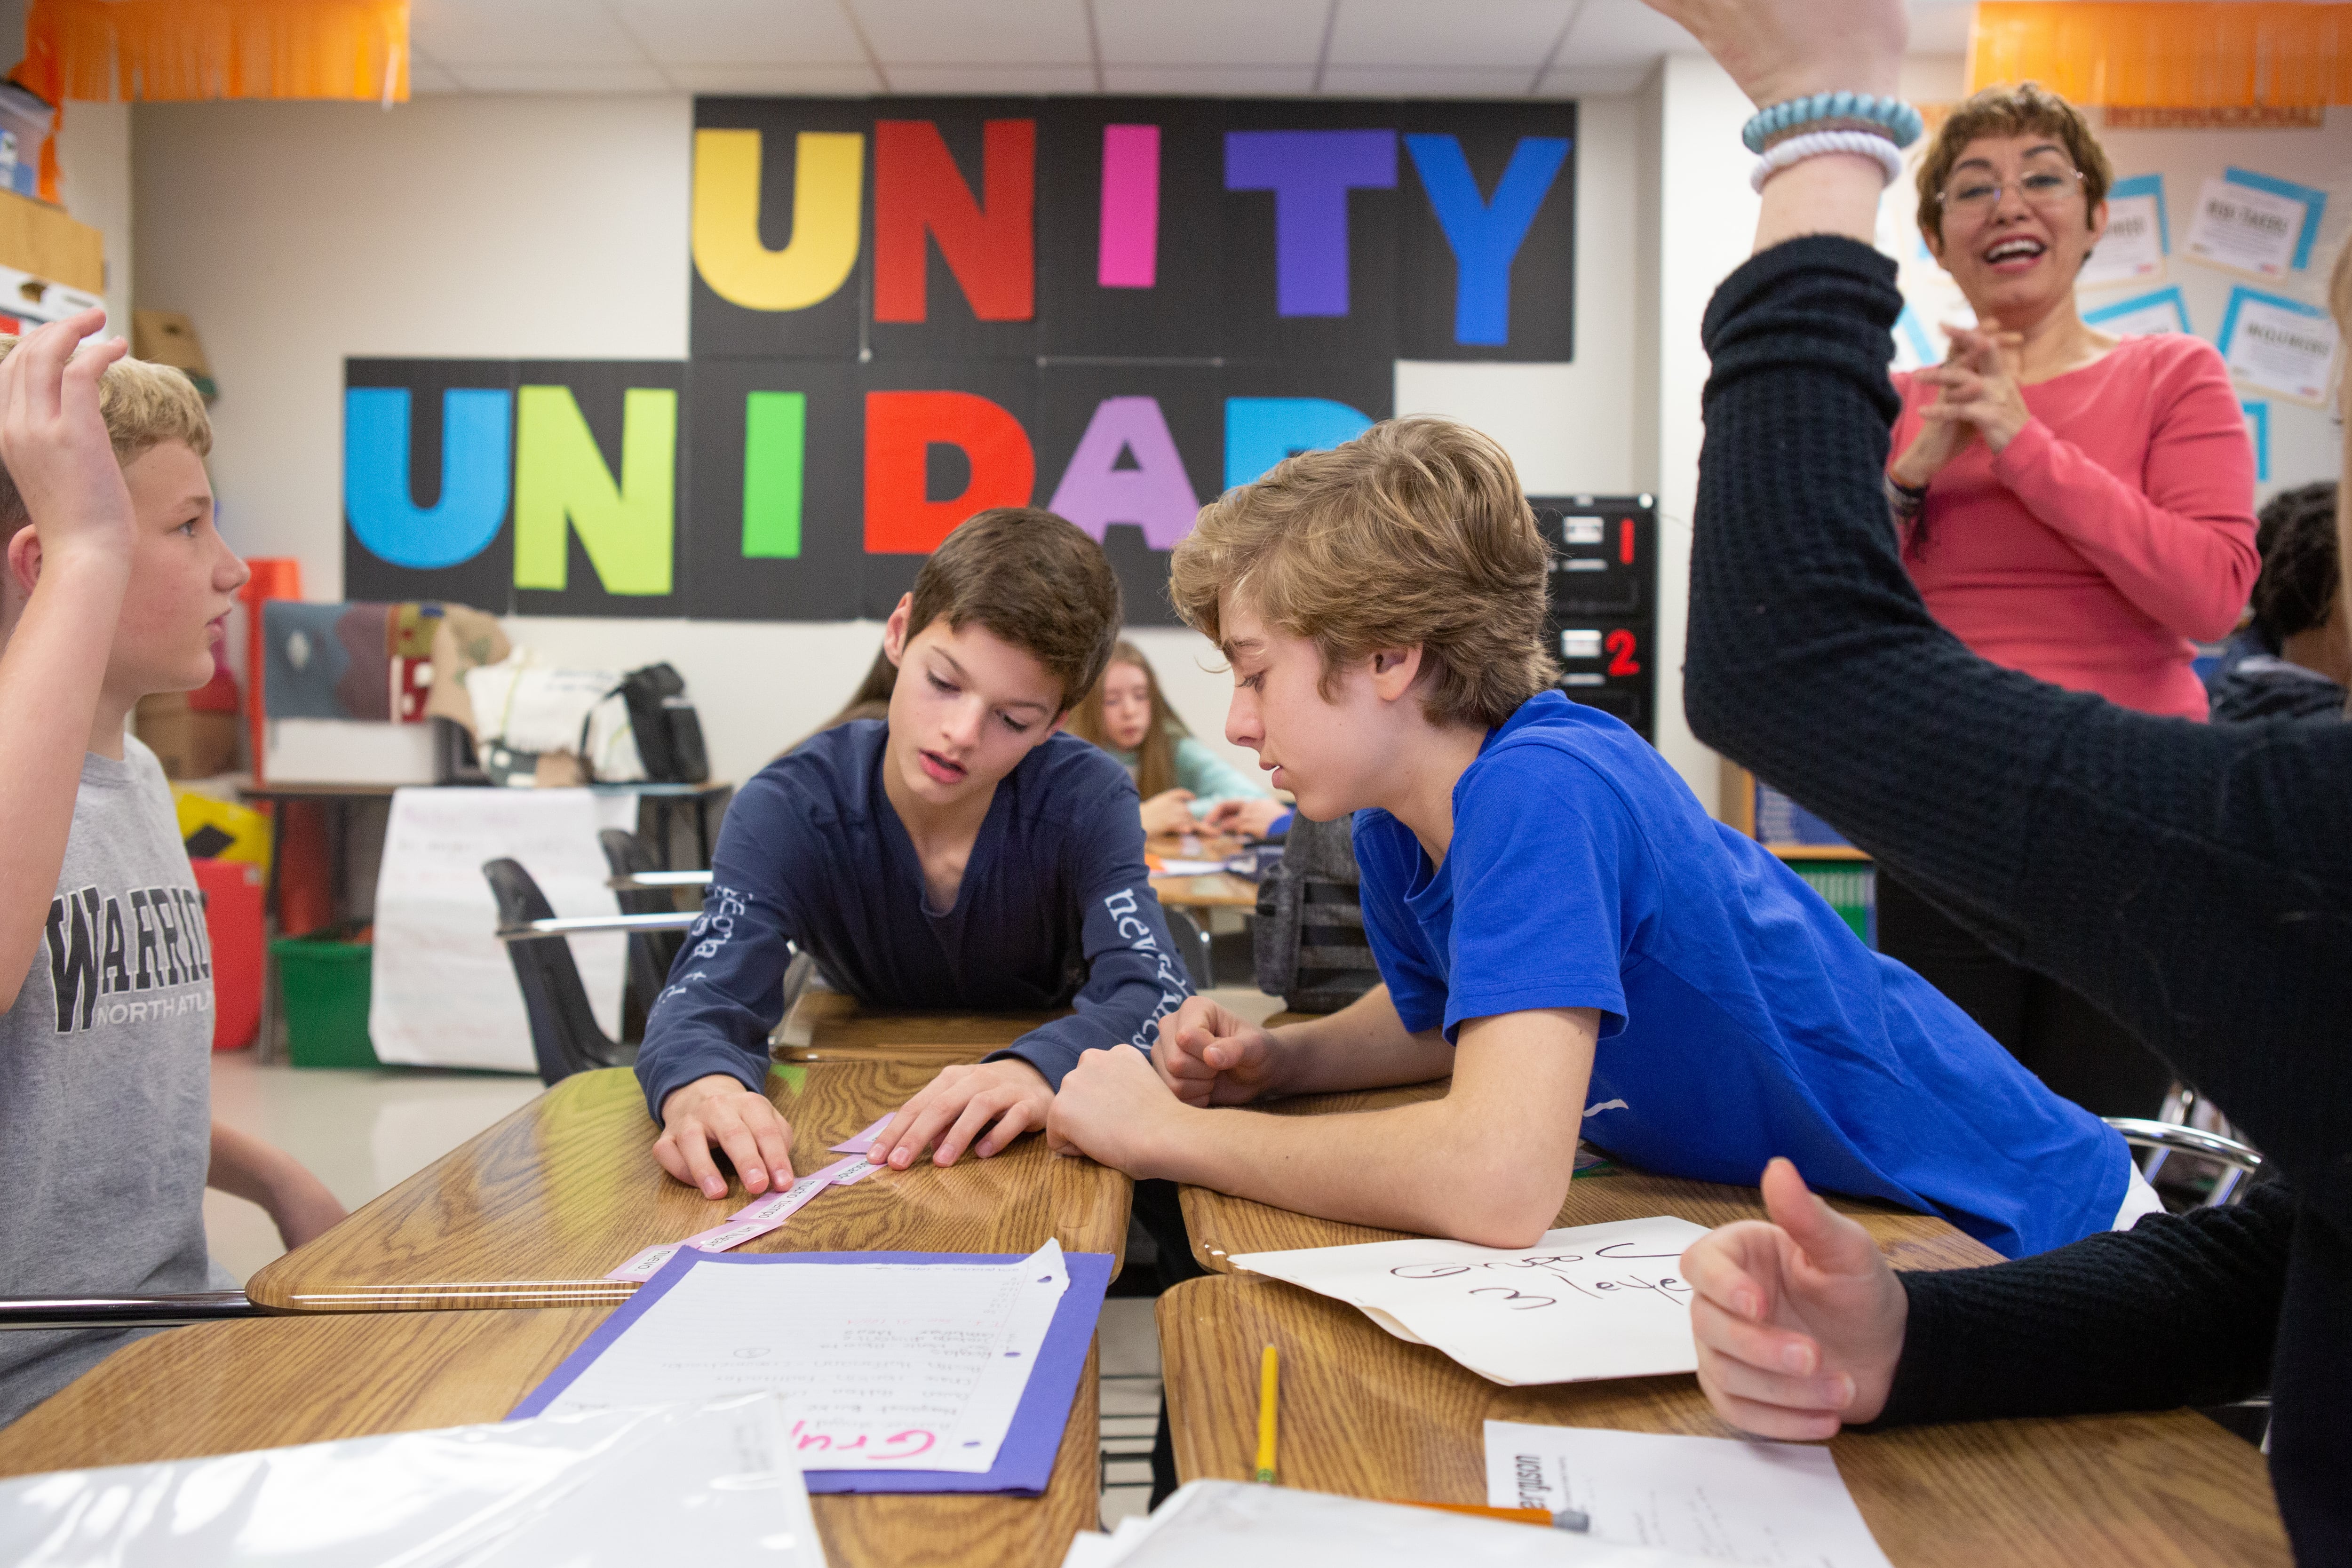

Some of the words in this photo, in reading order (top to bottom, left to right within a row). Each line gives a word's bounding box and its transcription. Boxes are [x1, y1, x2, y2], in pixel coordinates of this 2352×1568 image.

[689, 119, 1573, 346] UNITY
[1604, 628, 1641, 677] 2
[96, 998, 175, 1027] NORTH
[834, 1161, 870, 1180] uscando
[787, 1180, 815, 1199] mucho
[758, 1200, 792, 1219] tiempo
[707, 1233, 745, 1247] lugar
[1468, 1287, 1557, 1310] 3
[1515, 1455, 1551, 1509] erguson
